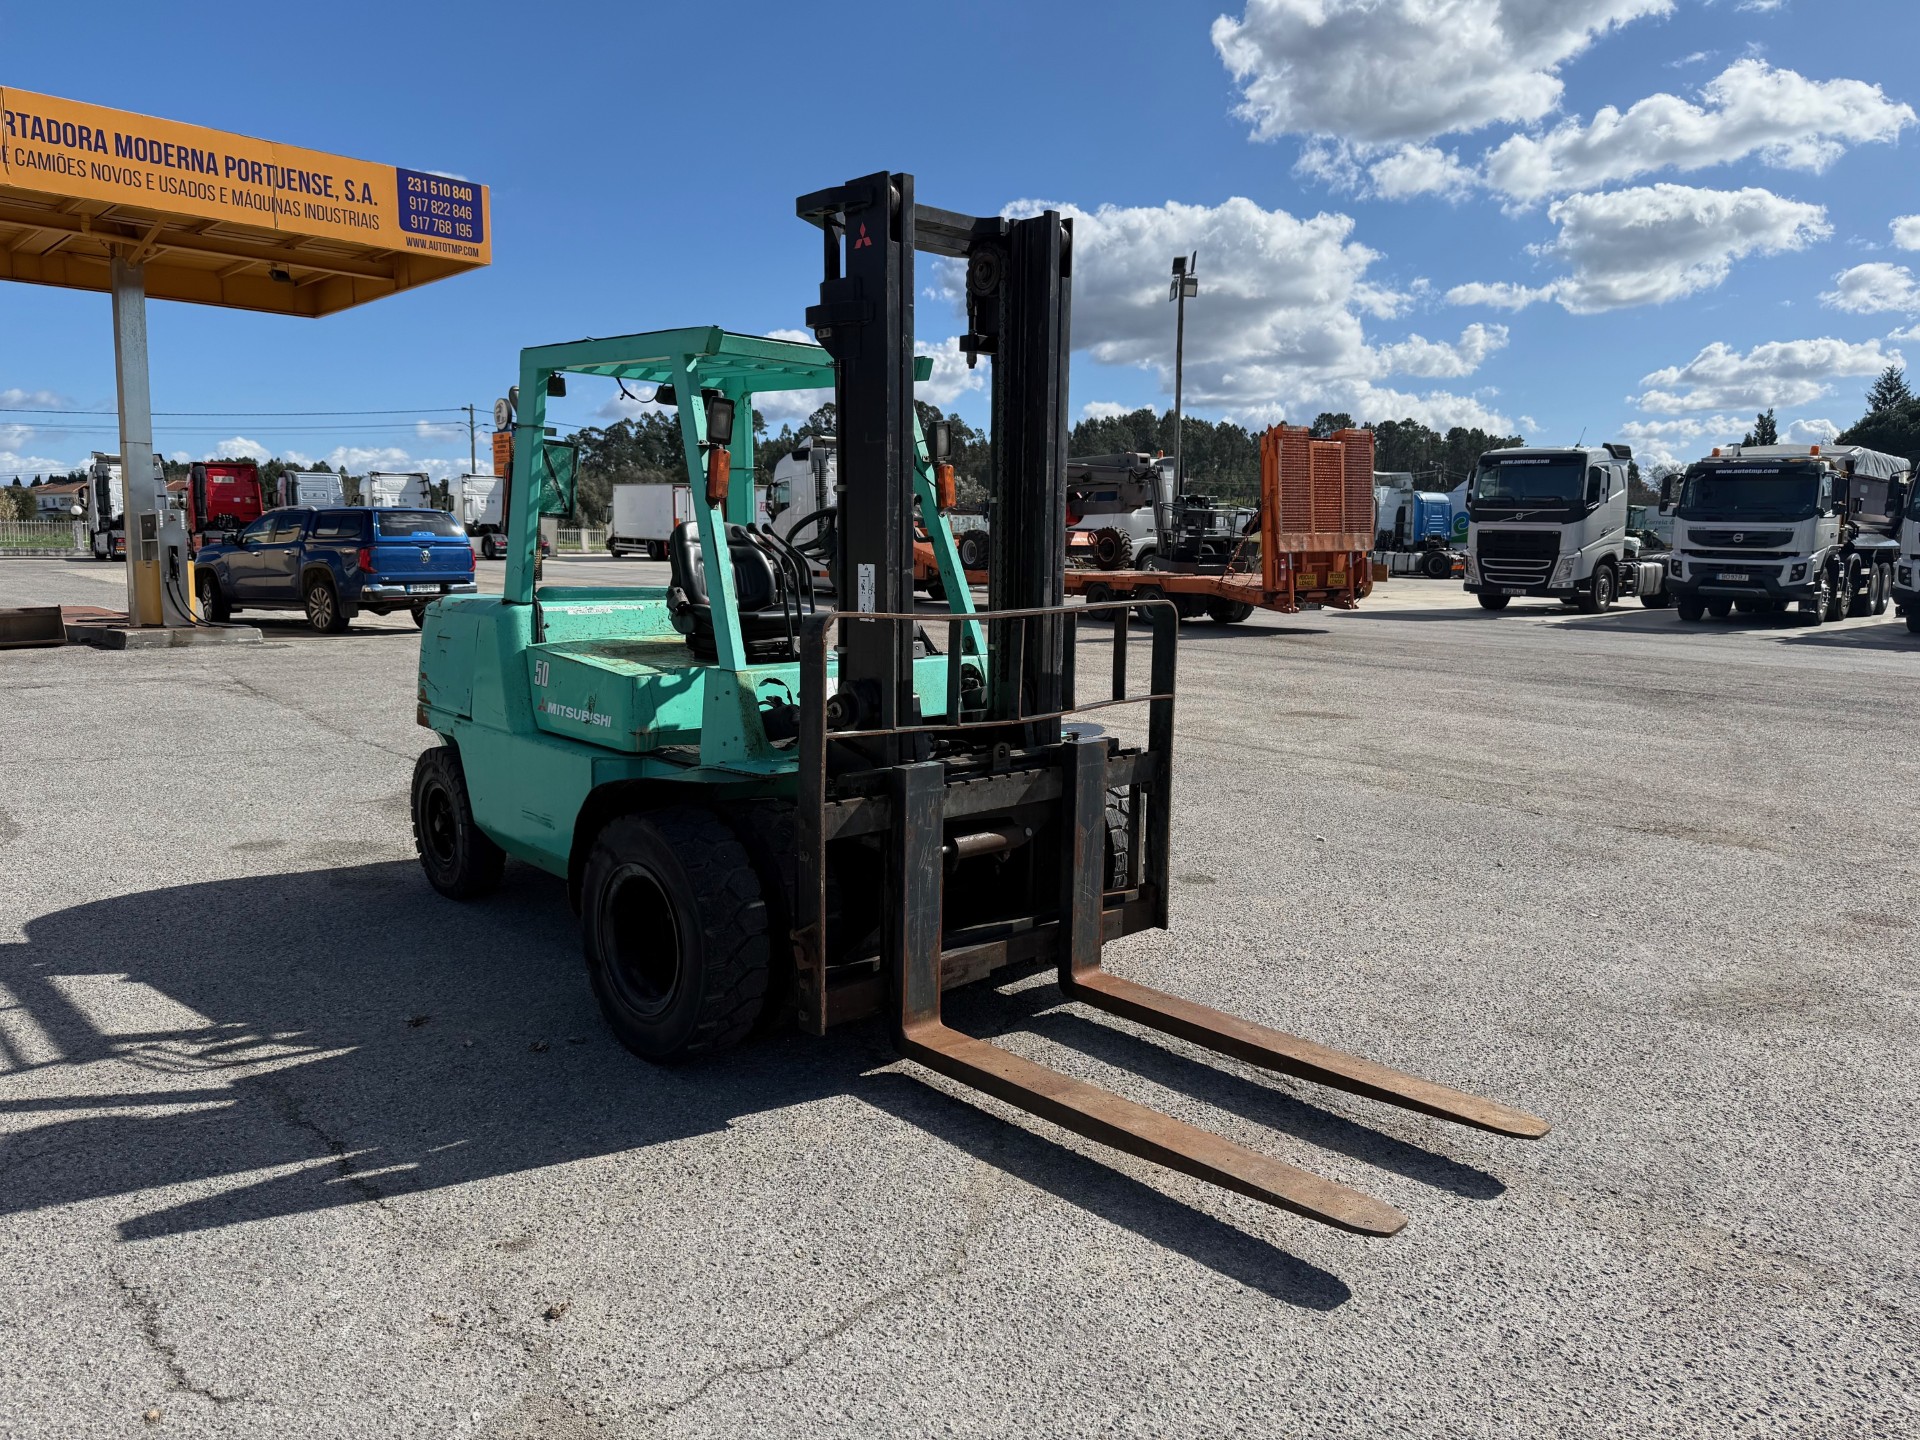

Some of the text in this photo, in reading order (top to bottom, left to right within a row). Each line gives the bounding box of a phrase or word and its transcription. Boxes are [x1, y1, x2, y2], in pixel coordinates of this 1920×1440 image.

[114, 132, 219, 177] MODERNA
[224, 155, 340, 203] PORTUENSE,
[344, 178, 379, 207] S.A.
[15, 147, 87, 178] CAMIÕES
[91, 161, 142, 188] NOVOS
[146, 172, 155, 191] E
[159, 175, 216, 202] USADOS
[220, 186, 228, 204] E
[232, 188, 301, 217] MÁQUINAS
[304, 202, 380, 231] INDUSTRIAIS
[407, 176, 473, 202] 231 510 840
[409, 195, 473, 220] 917 822 846
[411, 214, 473, 238] 917 768 195
[405, 236, 479, 258] WWW.AUTOTMP.COM
[534, 659, 550, 688] 50
[547, 701, 612, 728] MITSUBISHI
